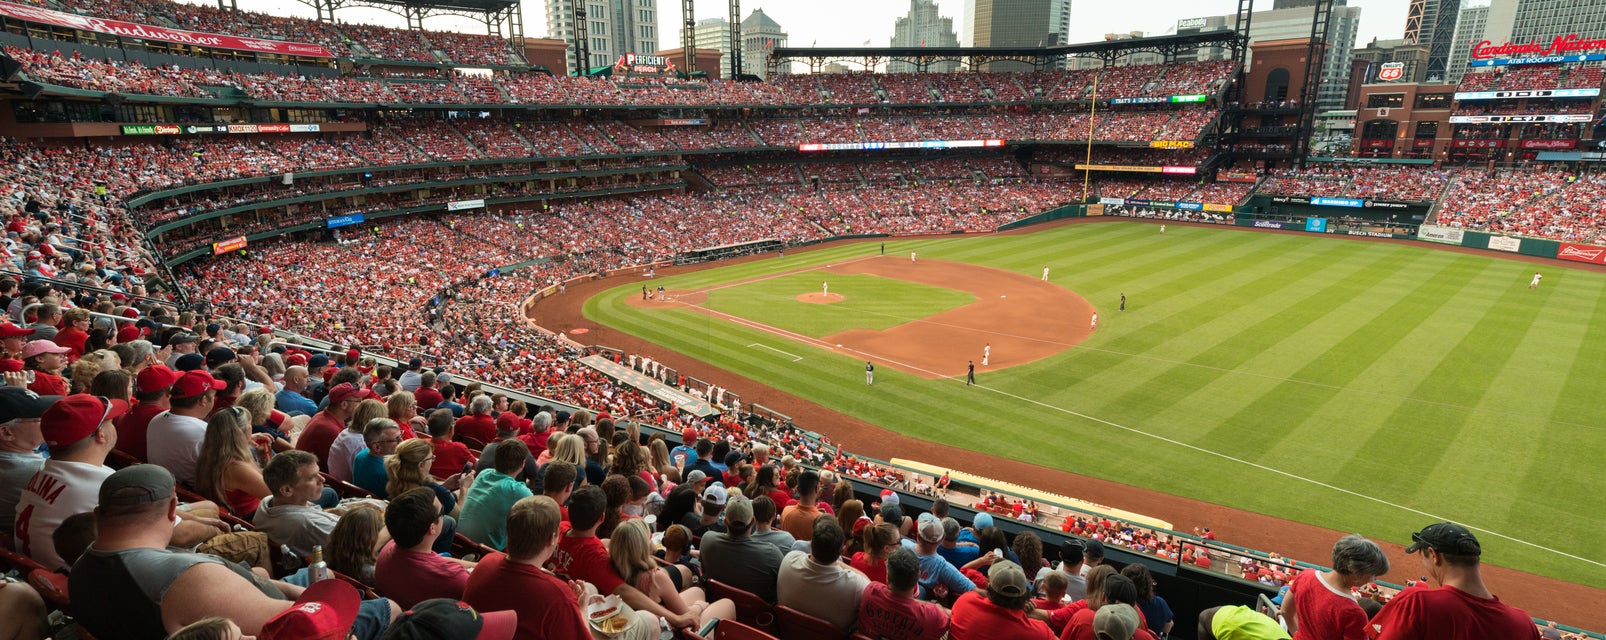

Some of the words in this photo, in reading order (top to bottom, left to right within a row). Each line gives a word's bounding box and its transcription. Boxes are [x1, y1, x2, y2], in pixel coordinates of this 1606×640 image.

[1179, 18, 1207, 27] Peabody
[91, 20, 222, 45] Budweiser
[1472, 39, 1541, 59] Cardinals
[1541, 33, 1606, 56] Nation
[626, 52, 664, 66] PERFICIENT
[1526, 56, 1564, 64] ROOFTOP
[1382, 69, 1400, 78] 66
[15, 504, 34, 559] 4
[865, 603, 924, 636] Georgia
